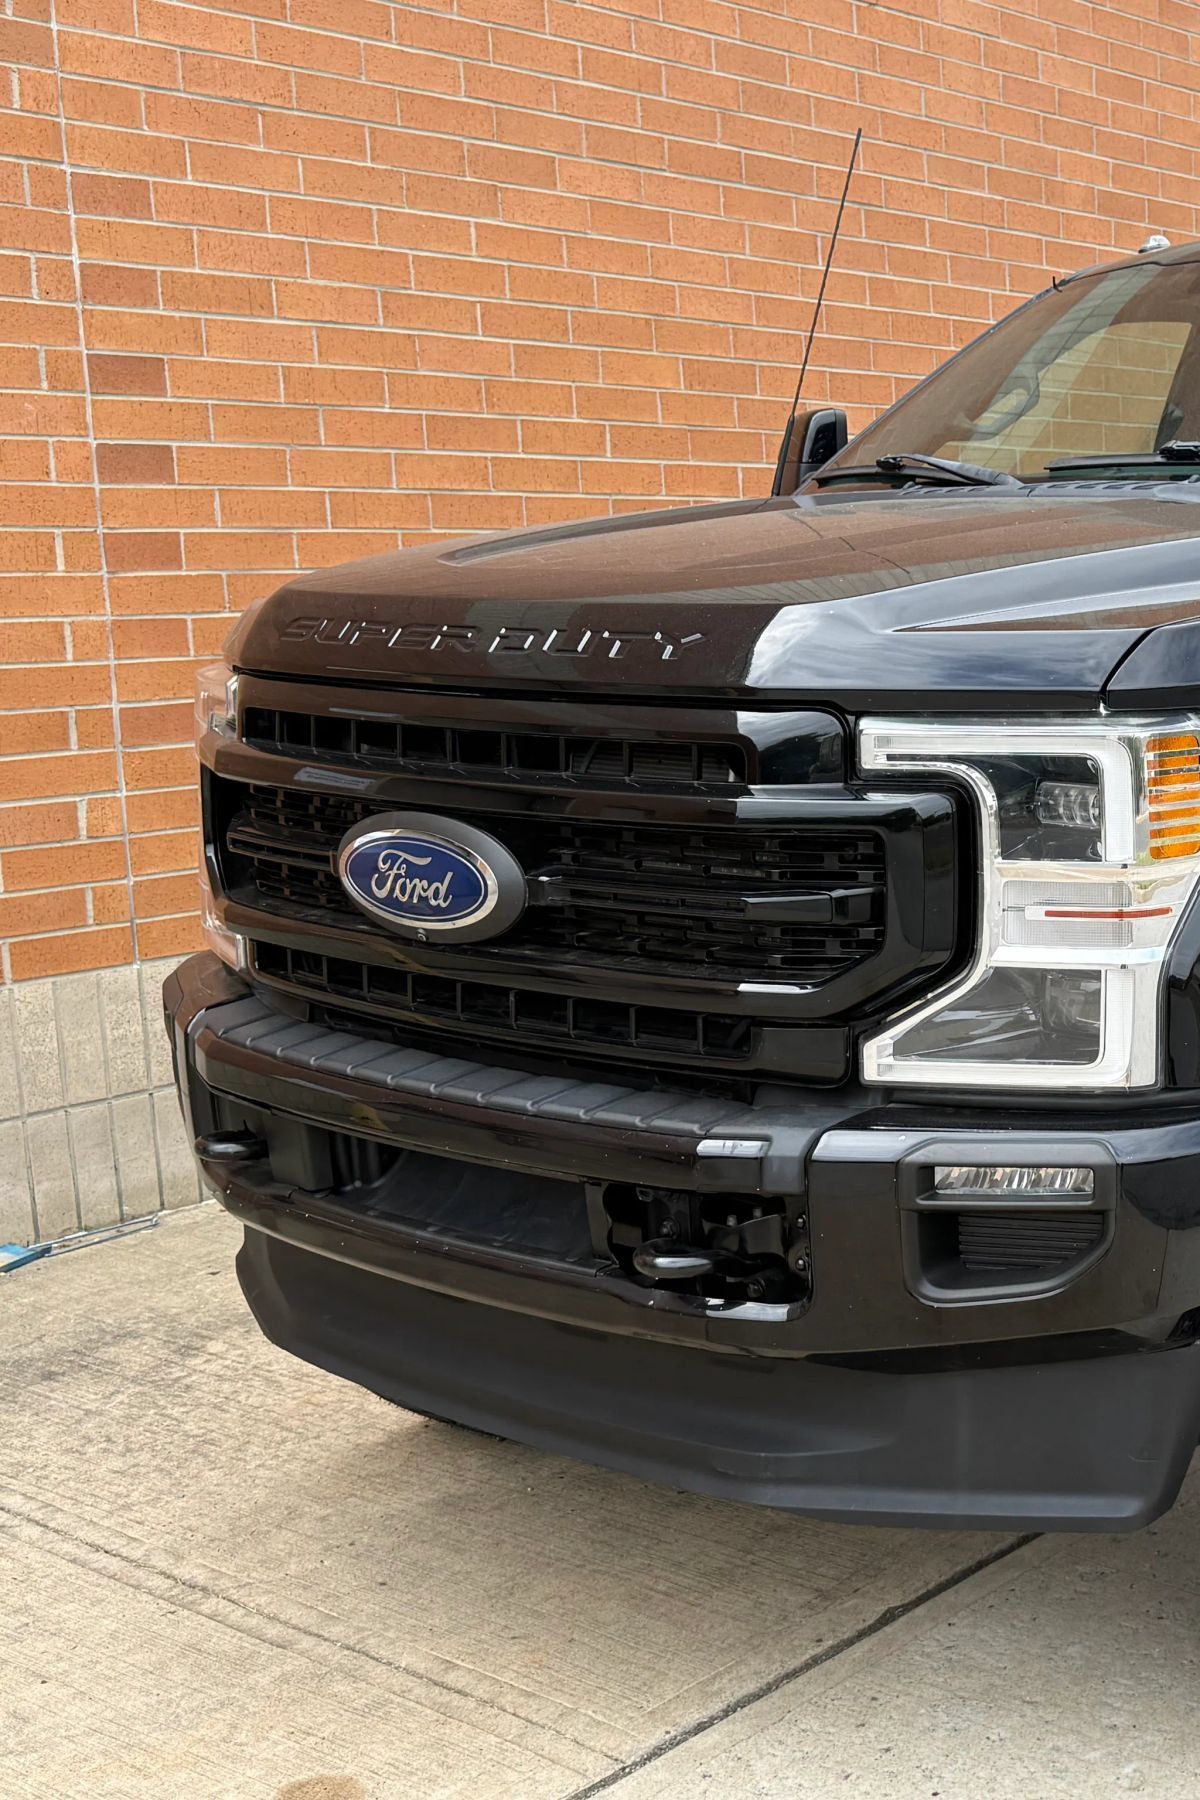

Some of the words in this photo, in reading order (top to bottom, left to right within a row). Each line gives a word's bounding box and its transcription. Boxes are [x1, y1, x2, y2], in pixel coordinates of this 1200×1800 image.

[280, 616, 477, 651] SUPER
[488, 626, 705, 660] DUTY
[370, 848, 453, 908] Ford
